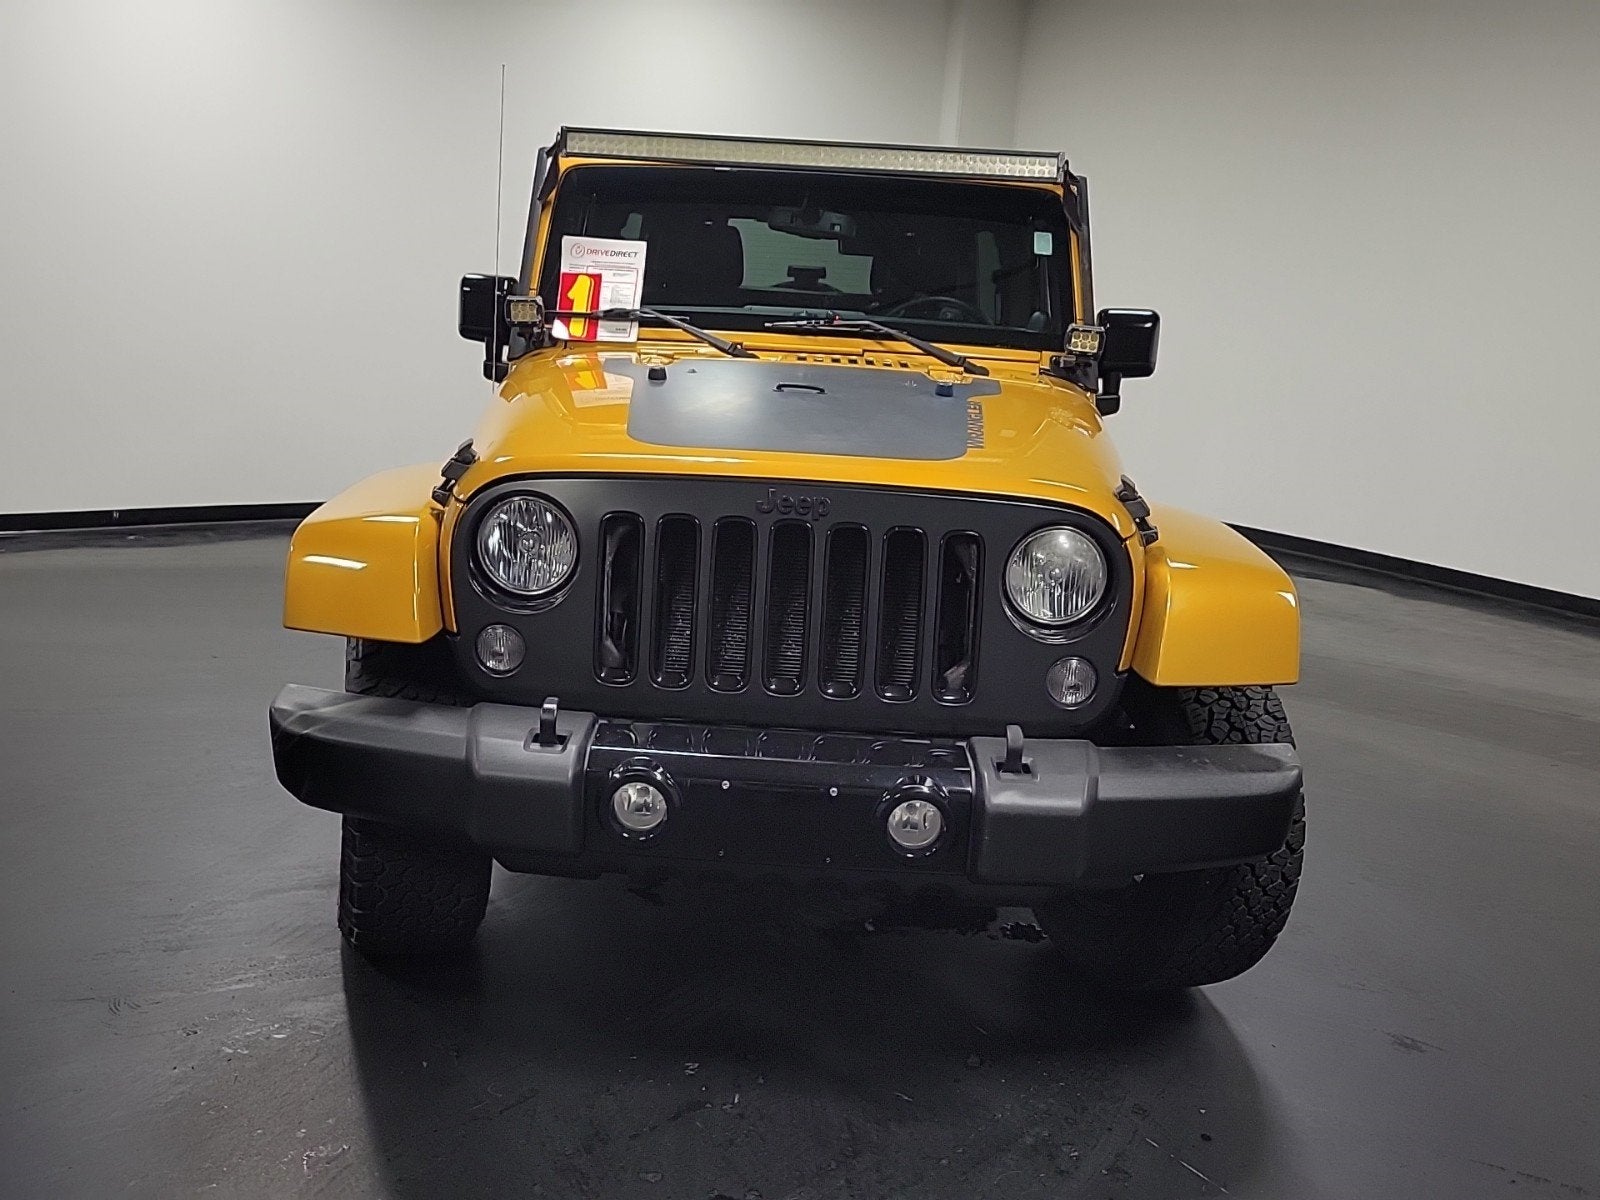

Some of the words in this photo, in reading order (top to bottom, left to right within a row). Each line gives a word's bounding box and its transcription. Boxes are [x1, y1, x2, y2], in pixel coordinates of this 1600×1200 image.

[567, 274, 594, 338] 1
[967, 400, 984, 449] WRANGLER
[756, 488, 831, 521] Jeep
